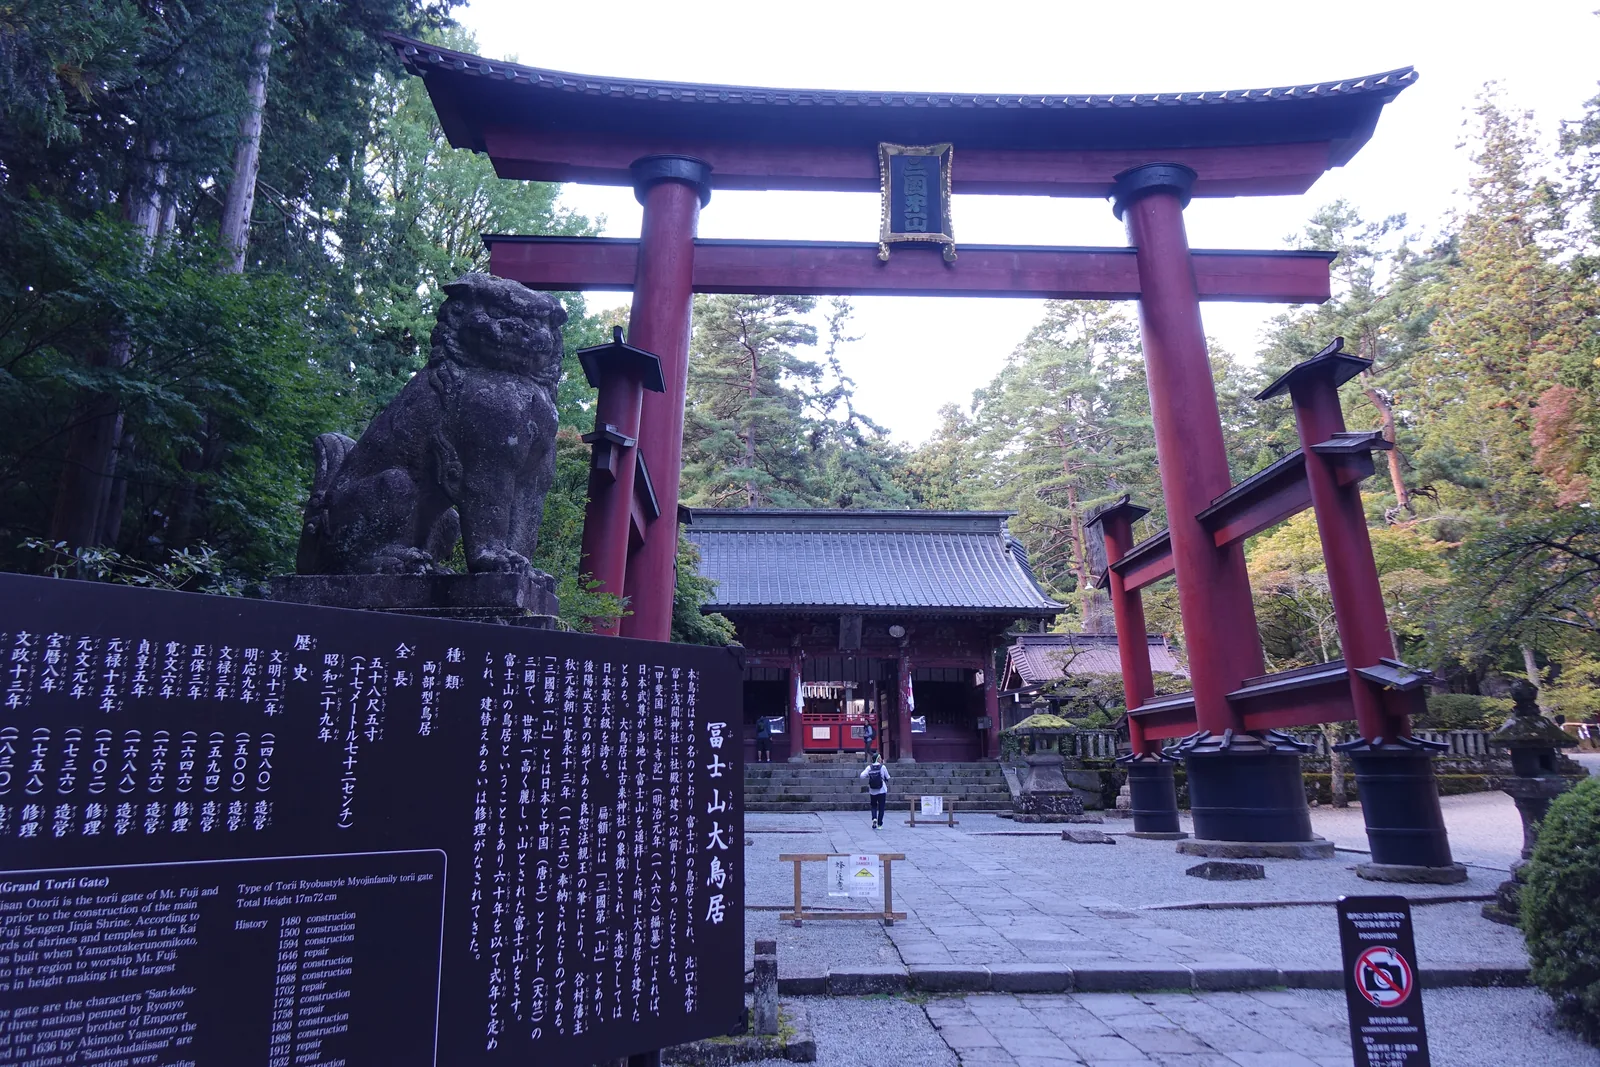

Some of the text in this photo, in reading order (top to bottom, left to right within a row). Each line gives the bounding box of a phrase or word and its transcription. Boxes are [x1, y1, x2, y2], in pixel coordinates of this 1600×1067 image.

[5, 631, 31, 709] 文政十三年
[40, 632, 64, 692] 宝暦八年
[70, 636, 92, 700] 元文元年
[131, 639, 152, 698] 貞享五年
[160, 640, 180, 699] 寛文六年
[188, 644, 206, 700] 正保三年
[215, 646, 233, 700] 文禄三年
[293, 634, 311, 682] 歴史
[393, 642, 410, 686] 全長
[445, 648, 461, 690] 種類
[100, 638, 124, 713] 元禄十五年
[240, 648, 259, 704] 明応九年
[264, 650, 283, 717] 文明十二年
[318, 654, 339, 743] 昭和二十九年
[364, 657, 384, 742] 五十八尺五寸
[418, 661, 436, 736] 両部型鳥居
[19, 804, 39, 838] 修理
[53, 804, 72, 837] 造営
[83, 802, 103, 836] 修理
[115, 802, 133, 835] 造営
[144, 802, 162, 834] 造営
[172, 801, 190, 832] 修理
[200, 800, 216, 832] 造営
[228, 800, 243, 832] 造営
[253, 800, 268, 831] 造営
[26, 896, 59, 908] Otorii
[76, 895, 92, 905] the
[96, 893, 118, 904] torii
[121, 893, 144, 904] gate
[180, 887, 199, 898] Fuji
[201, 886, 219, 896] and
[45, 878, 76, 890] Torii
[80, 877, 109, 888] Gate)
[238, 884, 261, 894] Type
[264, 882, 272, 892] of
[276, 880, 296, 890] Torii
[400, 873, 416, 882] torii
[417, 872, 434, 882] gate
[6, 900, 198, 925] prior the construction the main
[236, 898, 260, 908] Total
[263, 896, 292, 906] Height
[24, 924, 64, 936] Sengen
[68, 920, 92, 933] Jinja
[136, 913, 187, 926] According
[38, 923, 196, 946] shrines and temples the Kai
[235, 911, 356, 930] History 1480 construction
[306, 922, 355, 934] construction
[14, 951, 39, 962] built
[44, 949, 73, 960] when
[304, 934, 354, 946] construction
[304, 948, 330, 958] repair
[16, 966, 34, 976] the
[38, 962, 72, 974] region
[91, 955, 132, 967] worship
[28, 964, 175, 988] height making the largest
[302, 956, 352, 968] construction
[302, 966, 352, 980] construction
[300, 990, 350, 1004] construction
[301, 980, 327, 992] repair
[8, 1020, 38, 1031] three
[88, 1005, 126, 1021] penned
[130, 1004, 143, 1015] by
[146, 1000, 184, 1012] Ryonyo
[14, 1006, 39, 1018] gate
[43, 1004, 61, 1012] are
[65, 999, 82, 1010] the
[86, 992, 142, 1006] characters
[298, 1012, 348, 1028] construction
[299, 1004, 325, 1016] repair
[15, 1033, 34, 1044] the
[38, 1026, 83, 1040] younger
[86, 1020, 126, 1033] brother
[32, 1022, 197, 1054] 1636 by Akimoto Yasutomo the
[176, 1036, 192, 1046] are
[296, 1038, 322, 1052] repair
[297, 1024, 348, 1040] construction
[296, 1050, 321, 1064] repair
